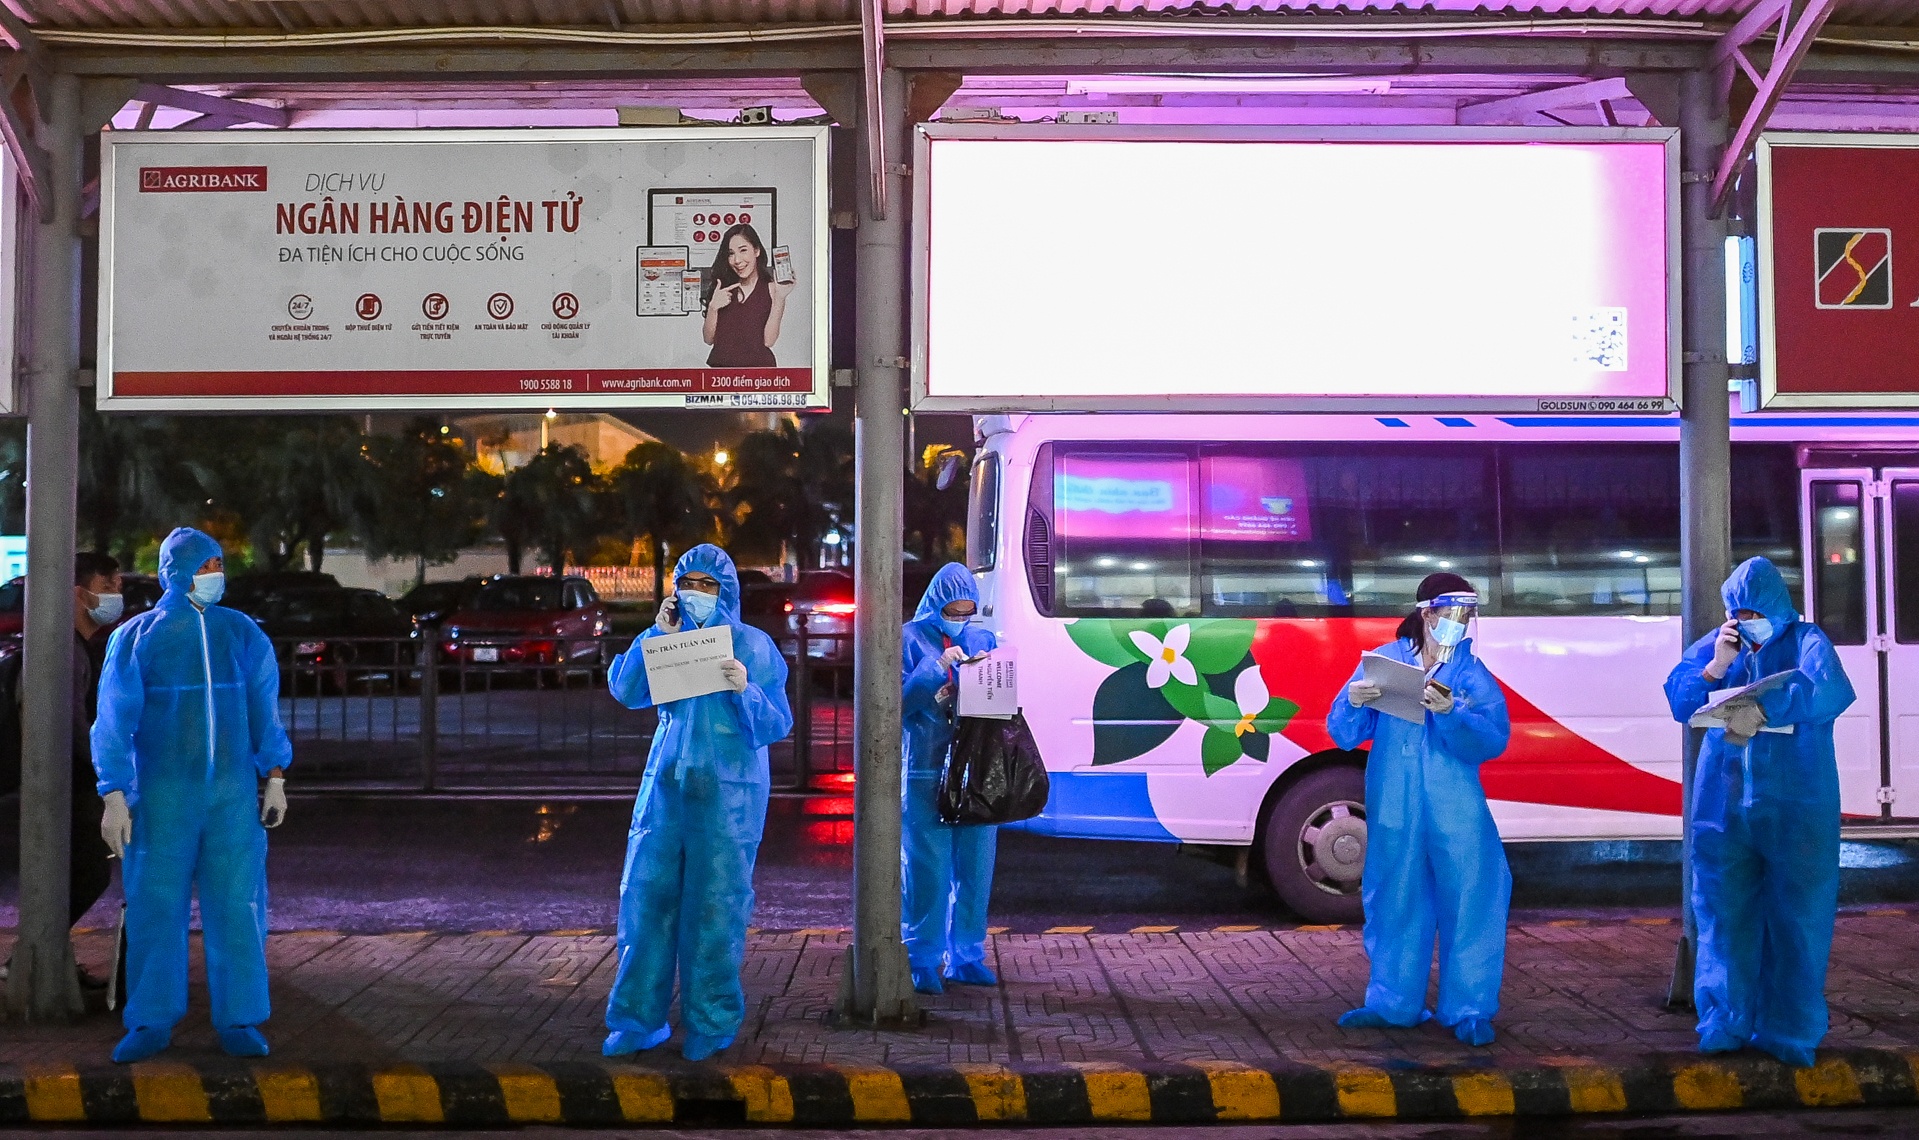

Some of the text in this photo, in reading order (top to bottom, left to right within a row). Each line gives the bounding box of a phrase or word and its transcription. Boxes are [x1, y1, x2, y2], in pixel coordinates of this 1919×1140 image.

[163, 173, 259, 188] AGRIBANK
[305, 172, 386, 195] DỊCH VỤ
[276, 190, 584, 242] NGÂN HÀNG ĐIỆN TỬ
[279, 241, 524, 266] ĐA TIỆN ÍCH CHO CUỘC SỐNG
[519, 379, 572, 390] 1900 5588 18
[601, 377, 692, 390] www.agribank.com.vn
[711, 376, 732, 387] 2300
[754, 377, 772, 389] giao
[773, 376, 791, 389] dịch
[685, 394, 807, 406] BIZMAN 094.986.98.98
[1540, 401, 1662, 410] GOLDSUN 090 464 66 99
[700, 638, 716, 646] ANH
